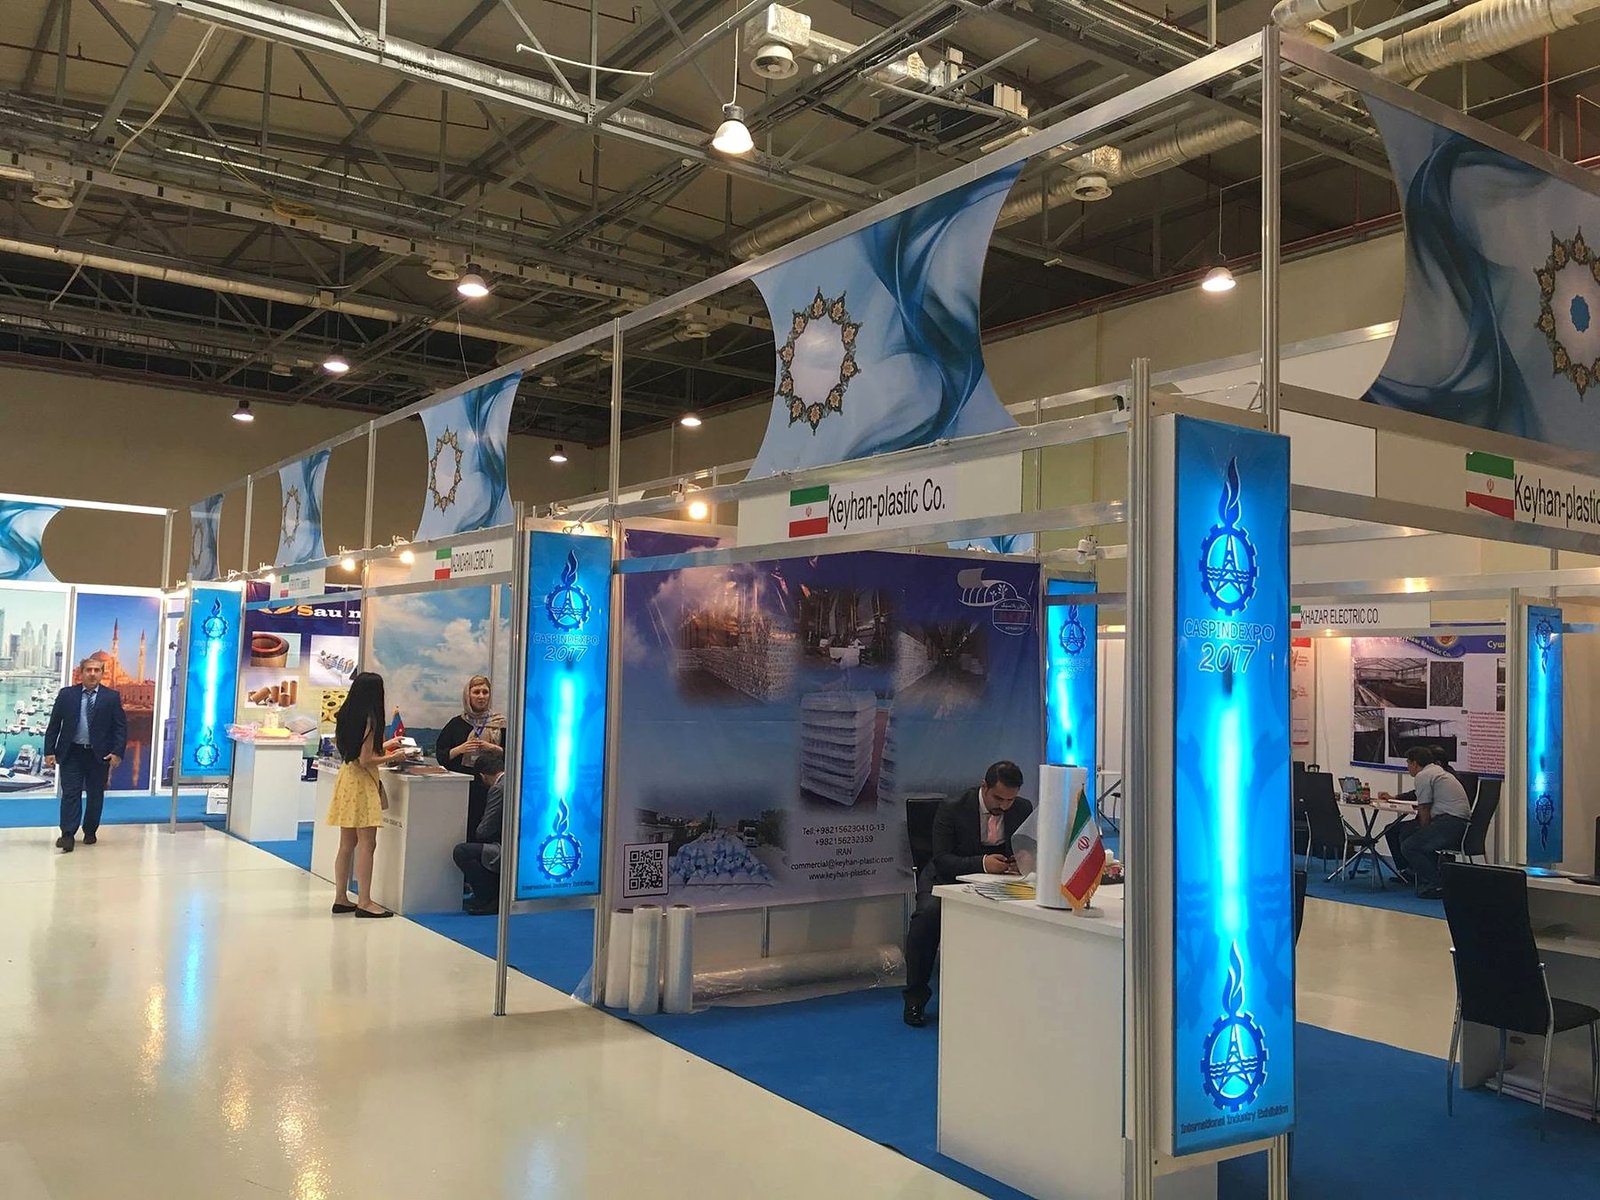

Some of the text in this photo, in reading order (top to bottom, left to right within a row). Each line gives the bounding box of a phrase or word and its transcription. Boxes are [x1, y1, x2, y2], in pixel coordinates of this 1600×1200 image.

[828, 478, 945, 530] Keyhan-plastic Co.
[1300, 607, 1380, 625] KHAZAR ELECTRIC CO.
[1184, 618, 1275, 642] CASPINDEXPO
[544, 645, 588, 662] 2017
[1199, 642, 1257, 673] 2017
[836, 847, 852, 856] IRAN
